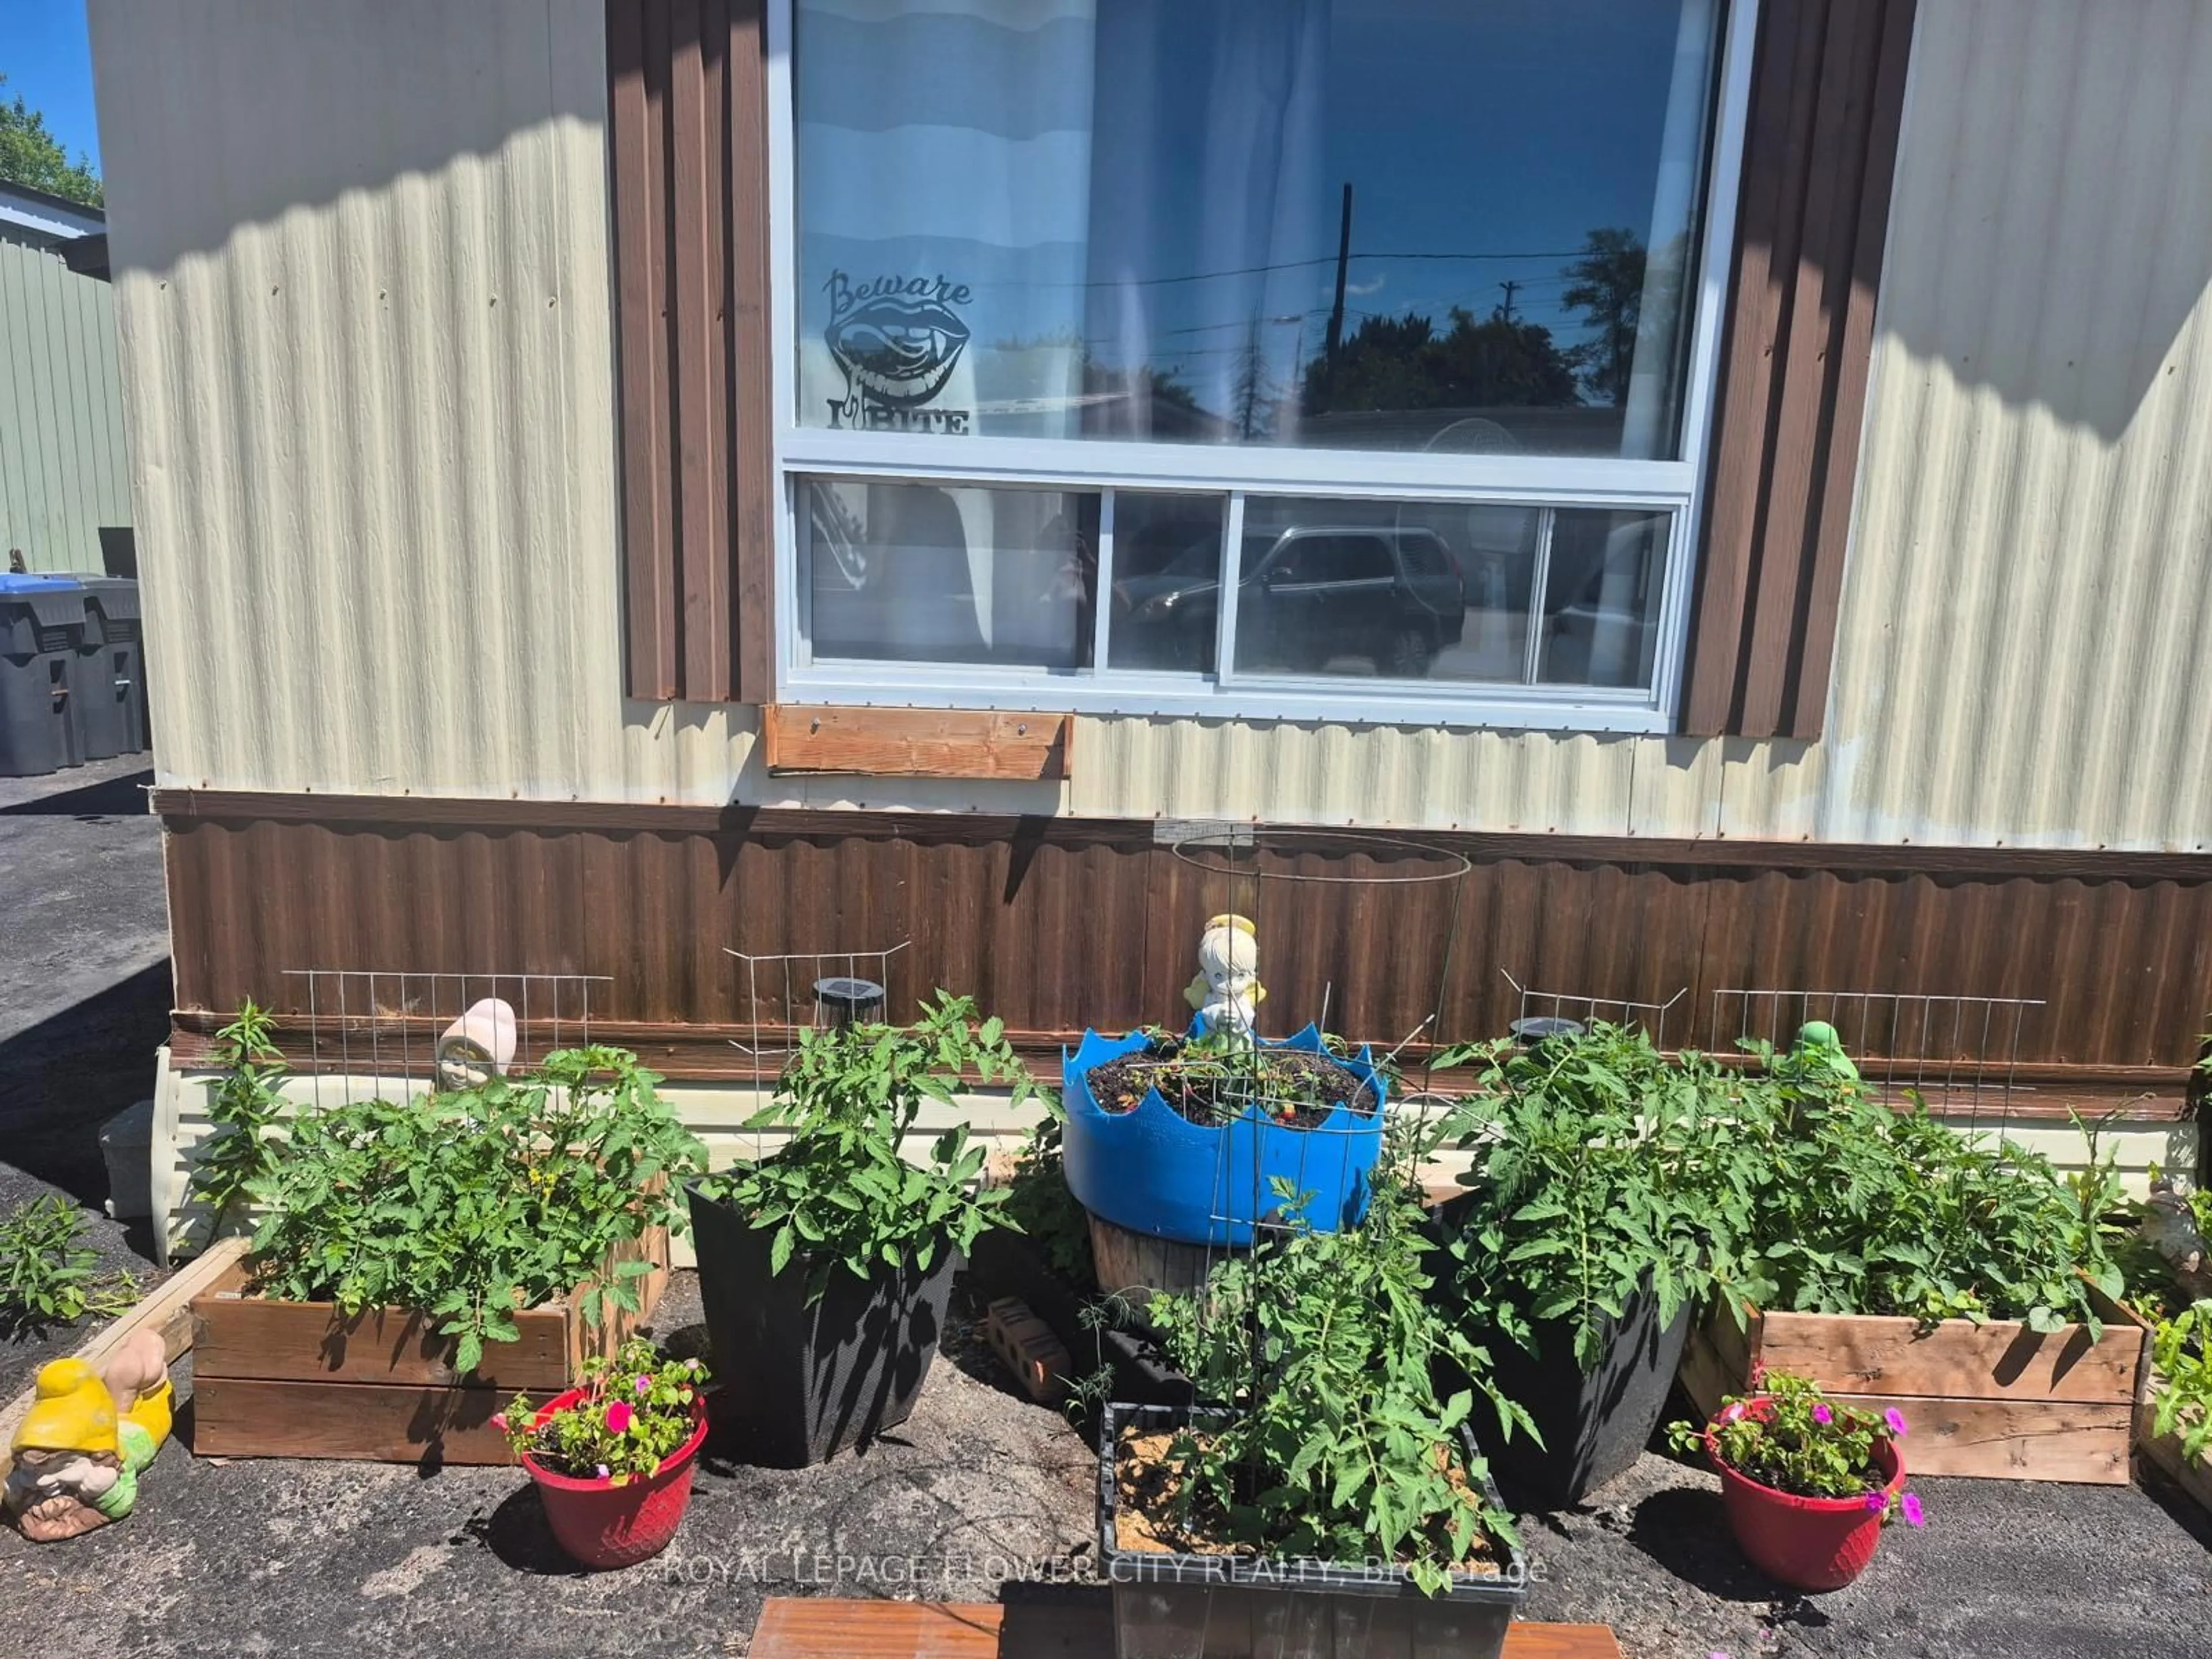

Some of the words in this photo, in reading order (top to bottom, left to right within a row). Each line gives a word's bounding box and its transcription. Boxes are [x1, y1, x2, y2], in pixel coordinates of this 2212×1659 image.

[822, 268, 974, 313] Beware
[827, 399, 844, 430] I
[865, 406, 969, 436] BITE
